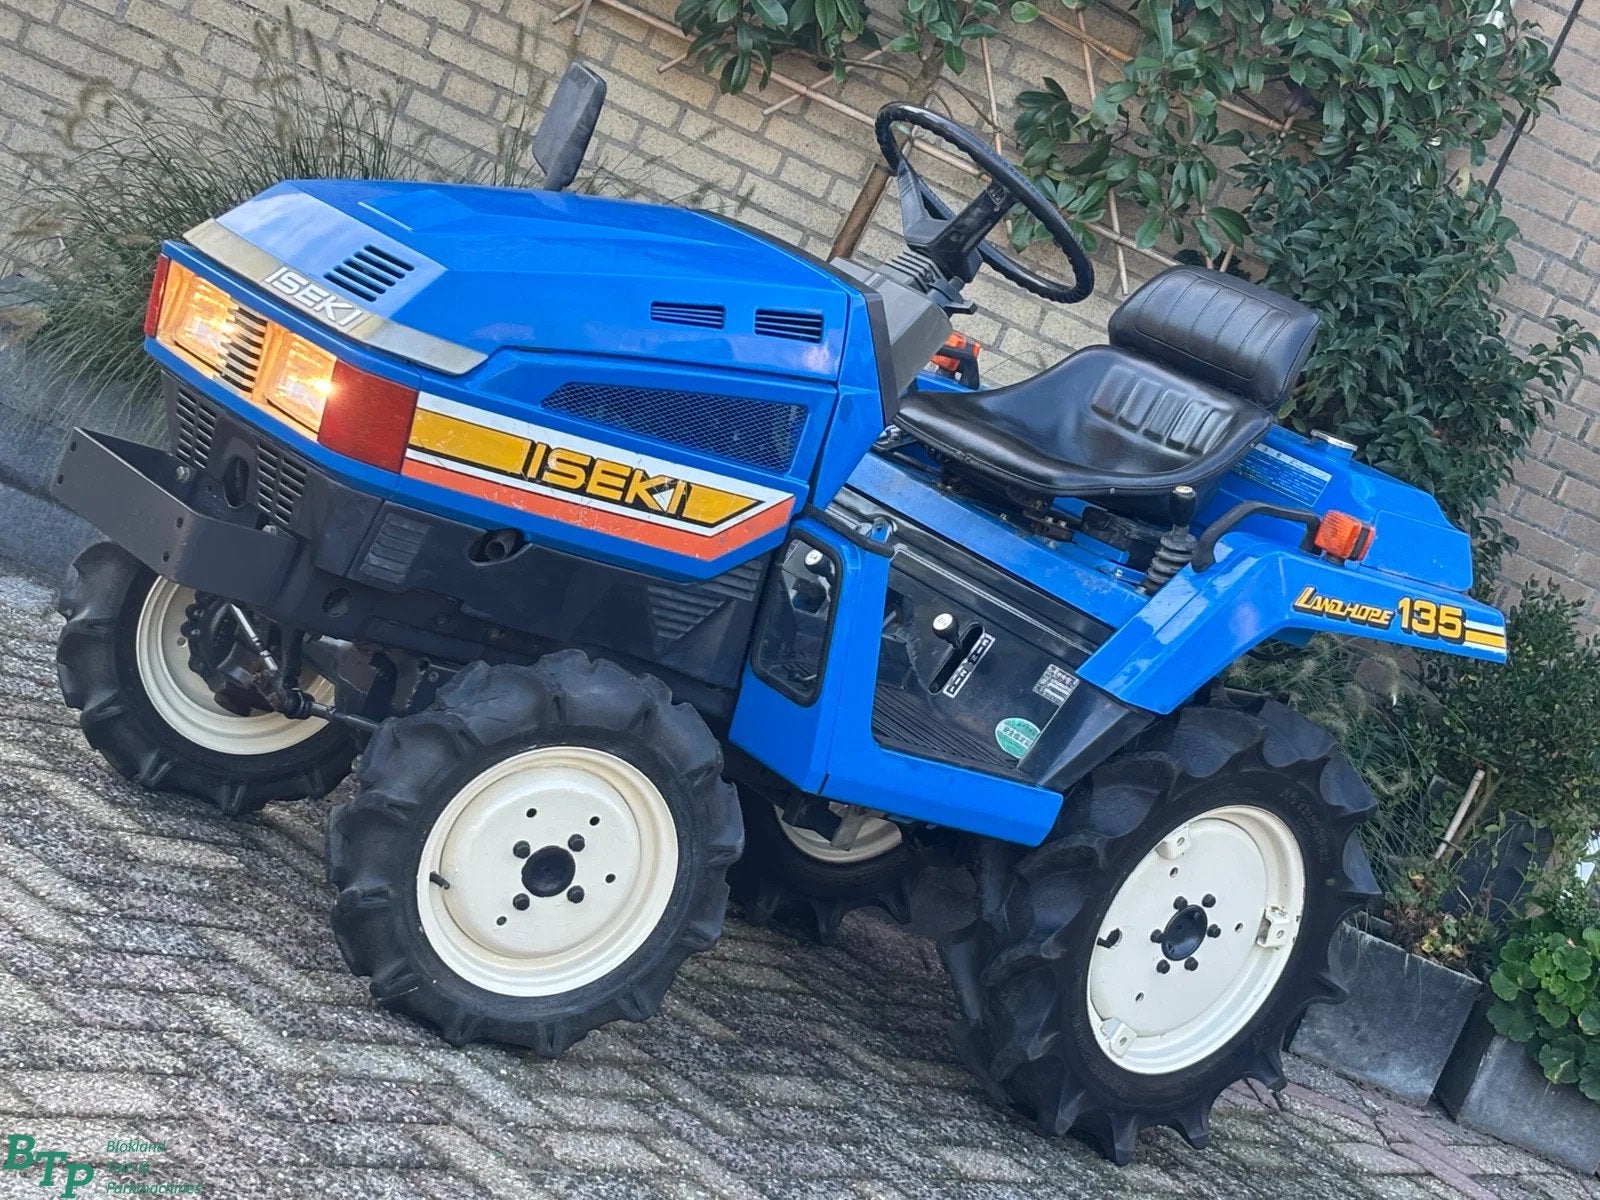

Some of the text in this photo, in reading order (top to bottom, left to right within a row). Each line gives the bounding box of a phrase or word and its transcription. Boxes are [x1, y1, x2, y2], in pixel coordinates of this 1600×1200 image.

[264, 266, 362, 326] ISEKI
[526, 442, 688, 516] ISEKI
[1398, 596, 1464, 642] 135
